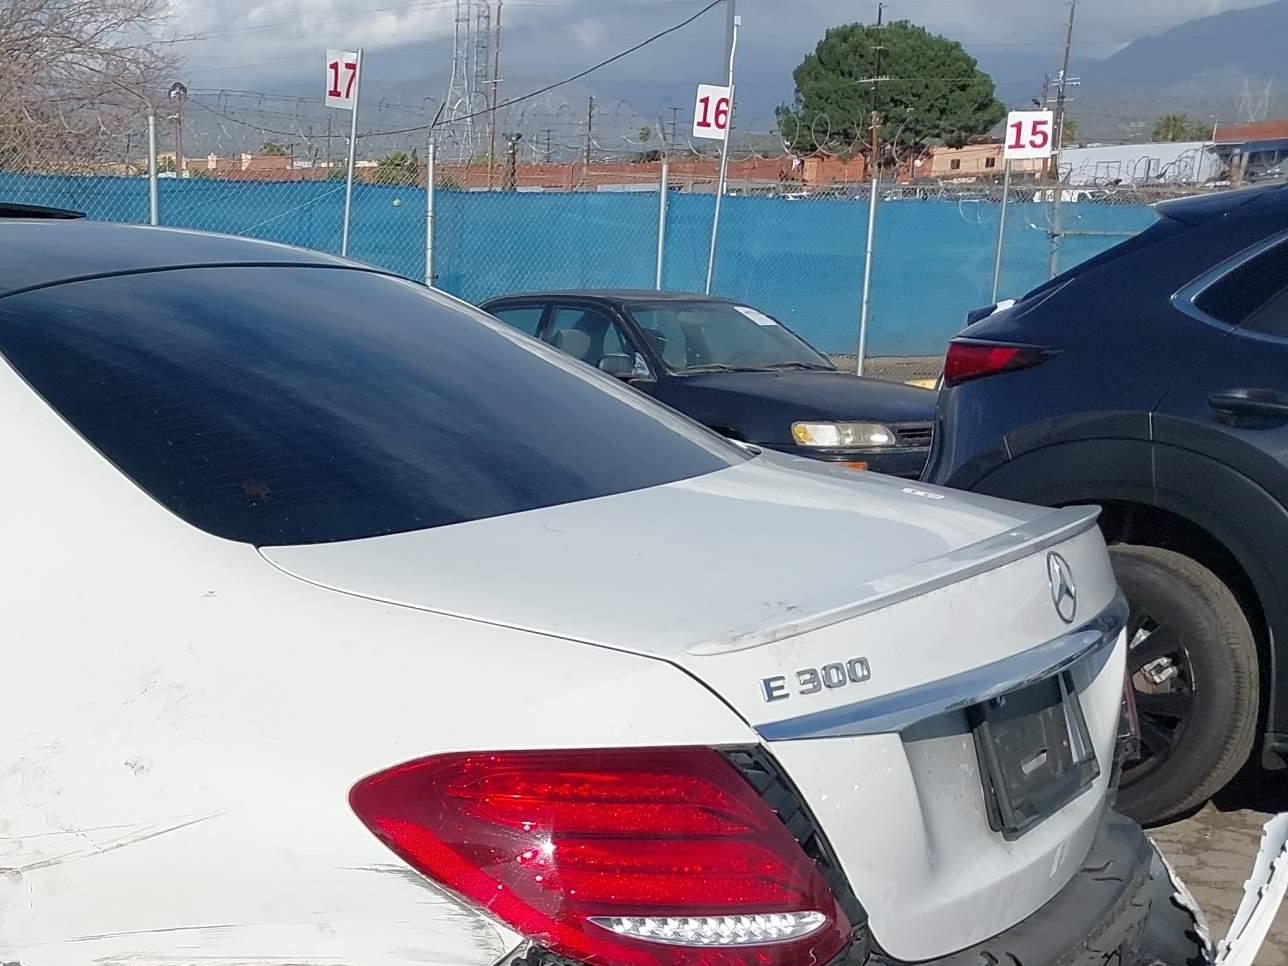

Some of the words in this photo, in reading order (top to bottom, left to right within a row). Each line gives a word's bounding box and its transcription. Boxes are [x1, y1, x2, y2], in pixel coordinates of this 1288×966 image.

[328, 61, 357, 99] 17
[696, 96, 729, 130] 16
[1008, 120, 1049, 149] 15
[760, 675, 791, 703] E
[795, 656, 872, 695] 300
